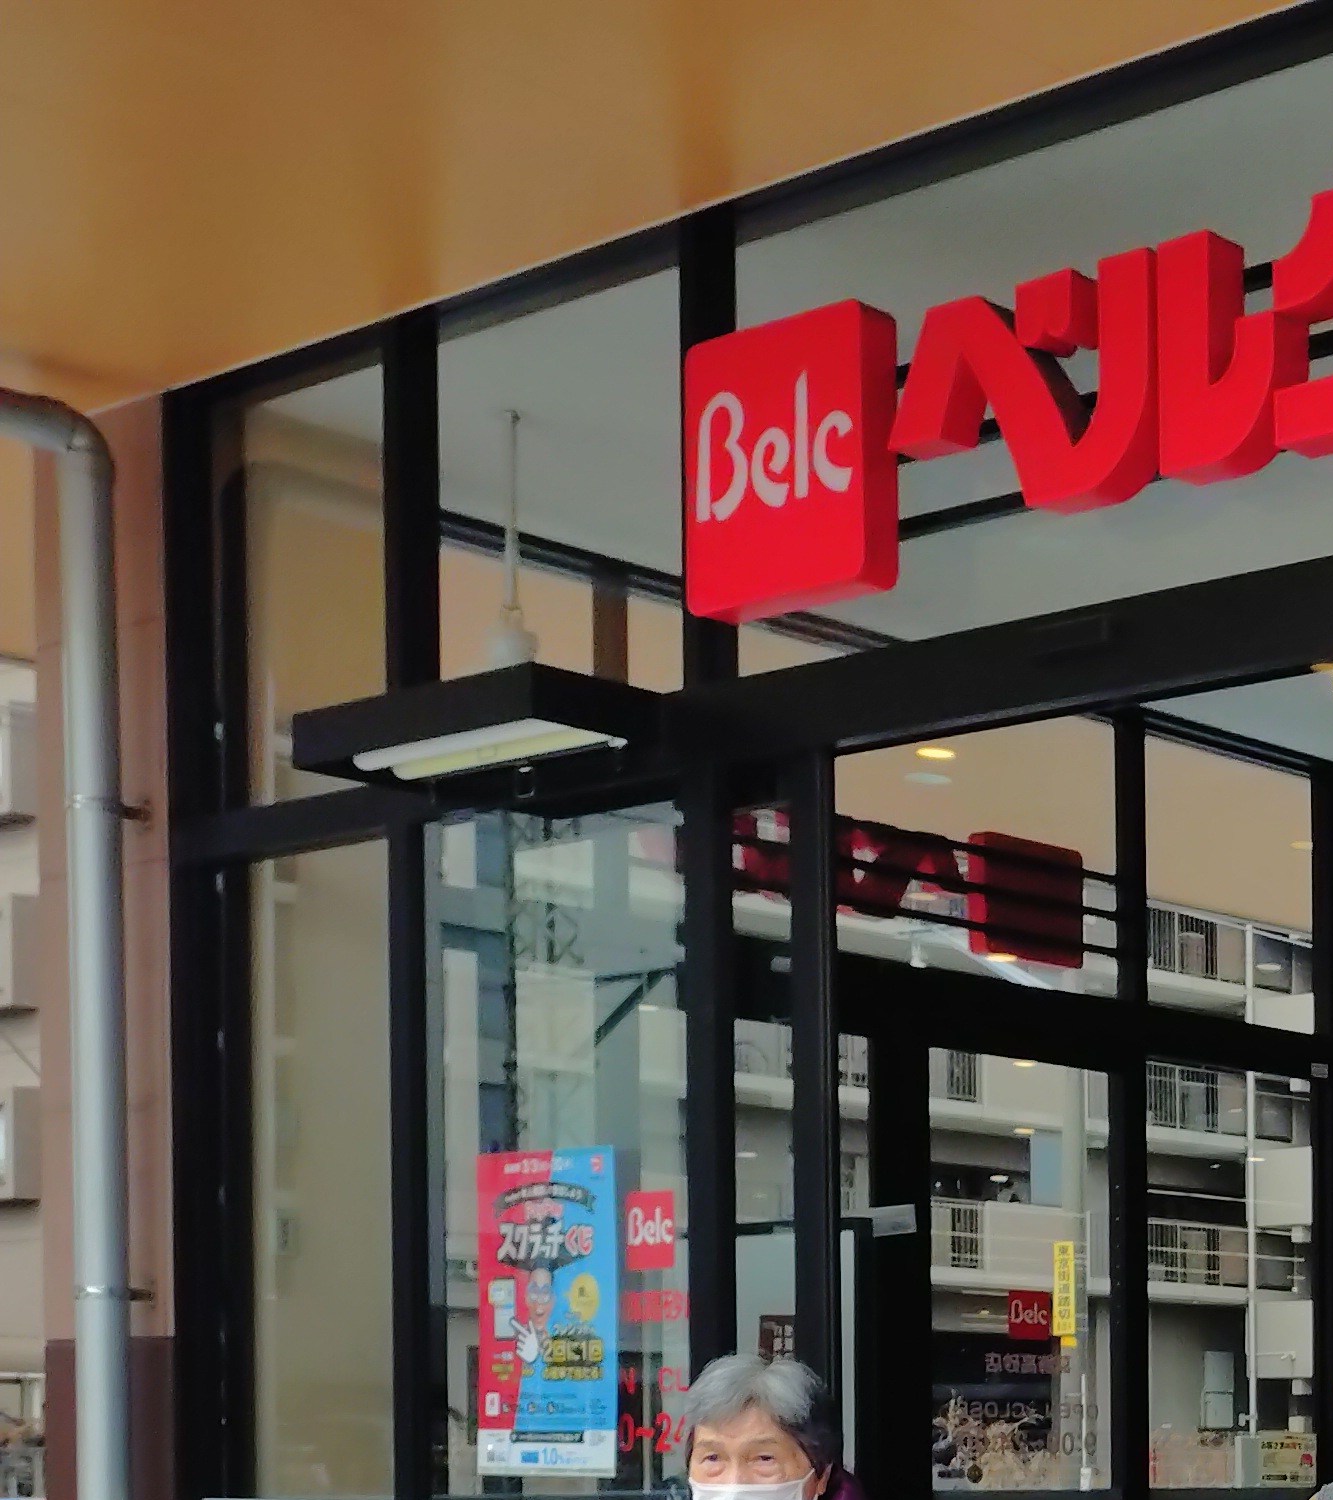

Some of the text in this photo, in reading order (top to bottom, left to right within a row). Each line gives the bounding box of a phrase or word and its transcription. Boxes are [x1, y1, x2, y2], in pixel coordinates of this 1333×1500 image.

[696, 371, 854, 523] Belc
[627, 1206, 674, 1246] Belc
[1010, 1300, 1048, 1326] Belc
